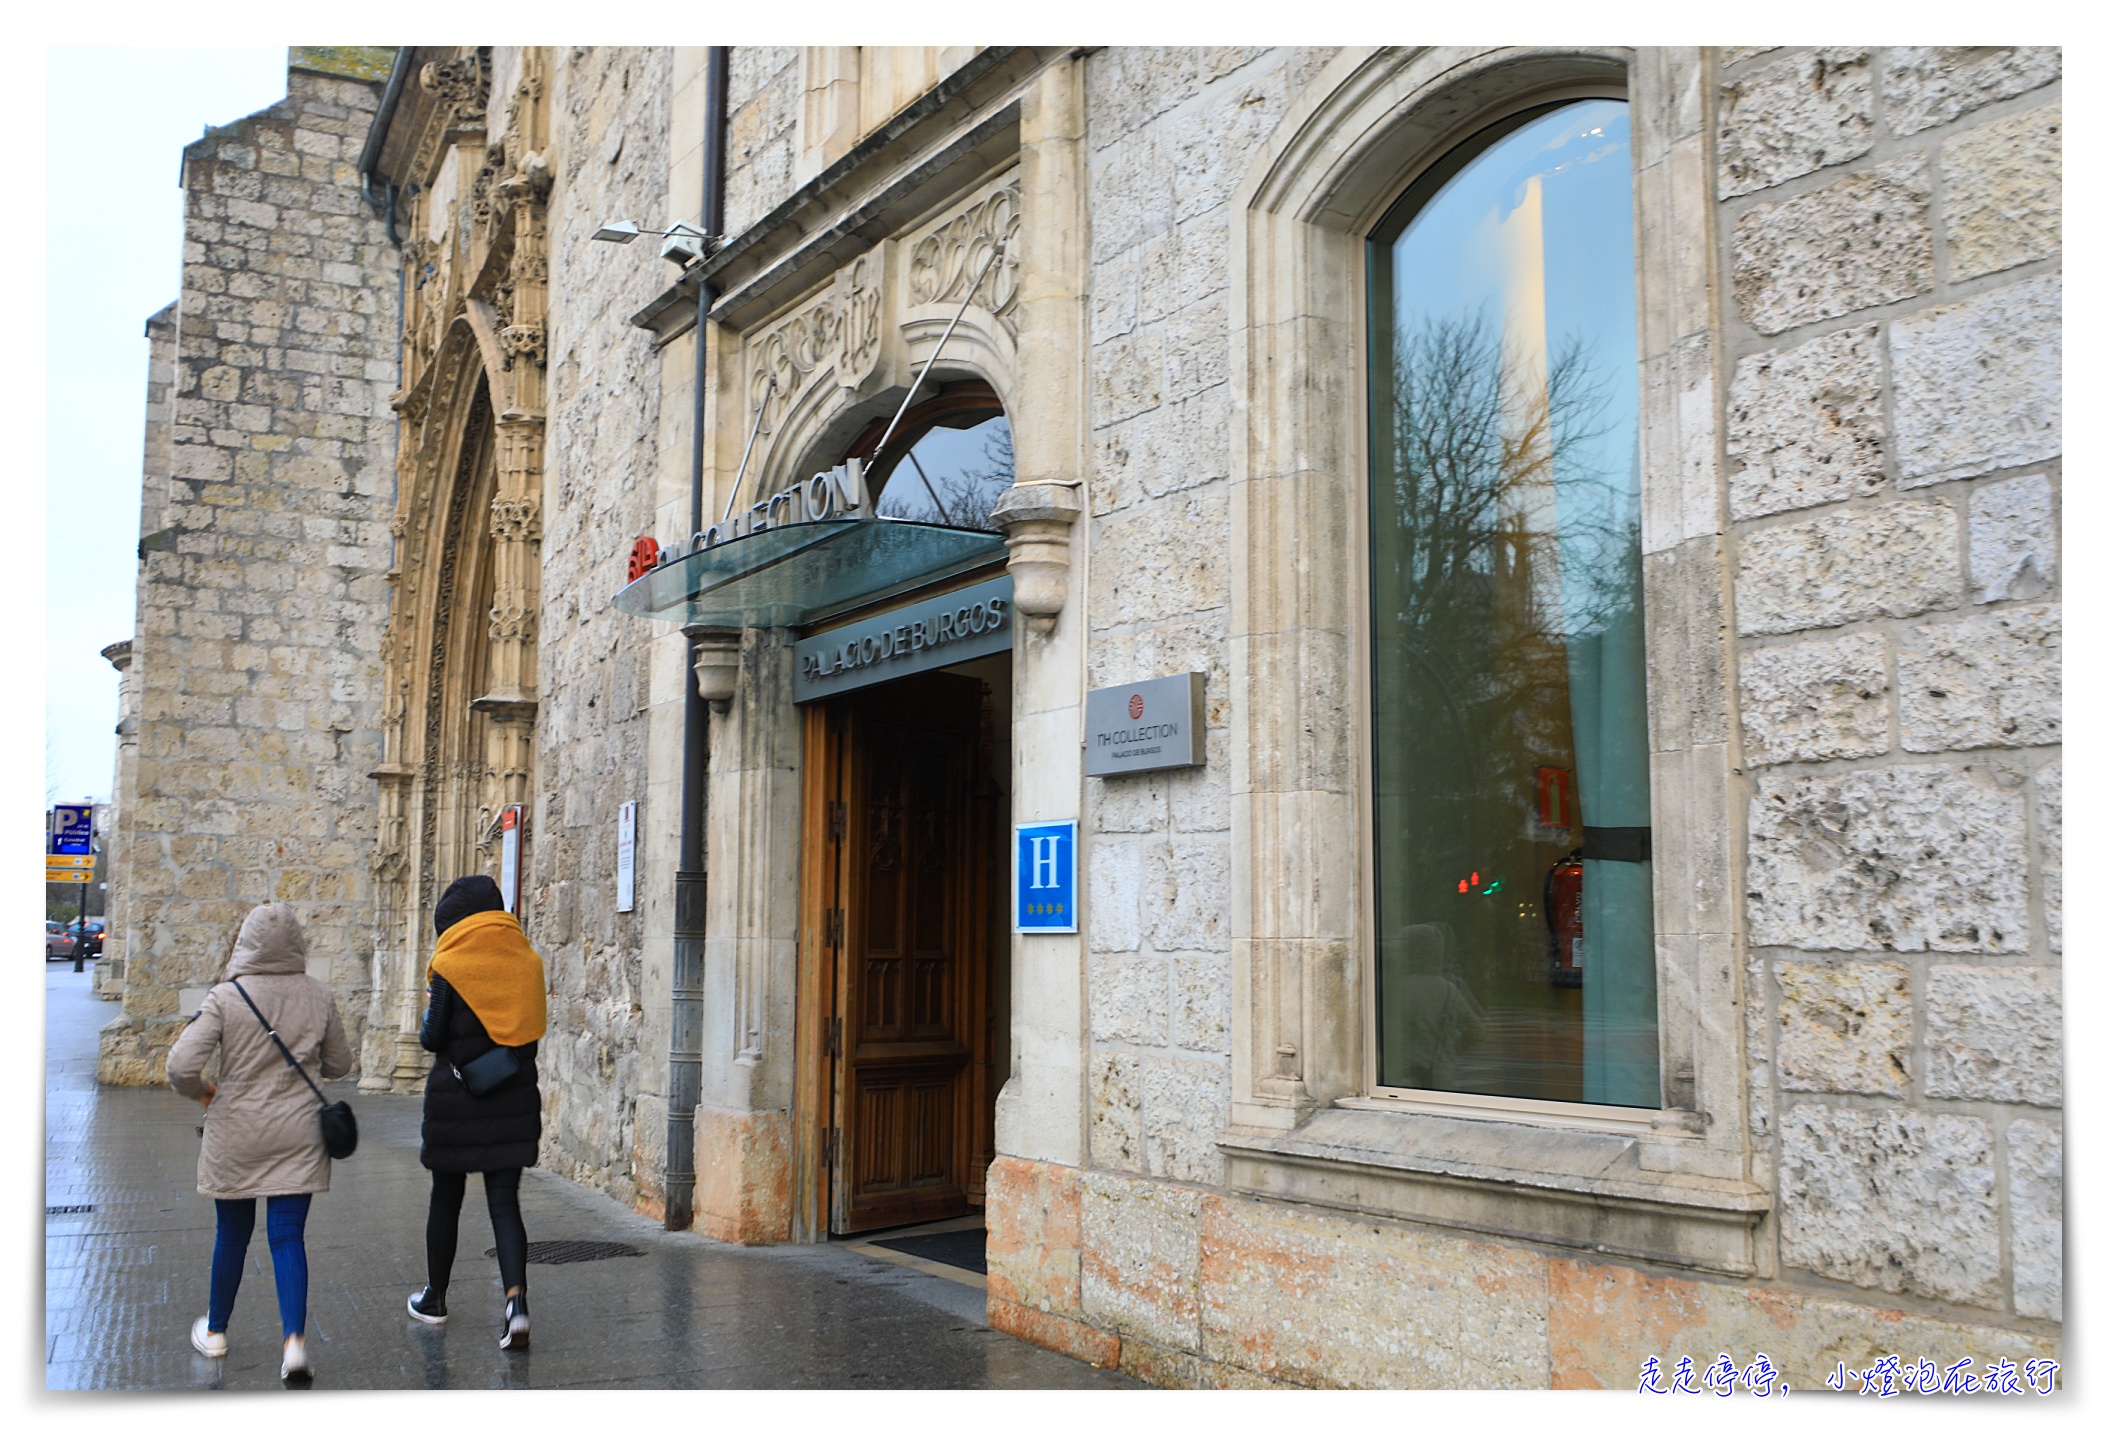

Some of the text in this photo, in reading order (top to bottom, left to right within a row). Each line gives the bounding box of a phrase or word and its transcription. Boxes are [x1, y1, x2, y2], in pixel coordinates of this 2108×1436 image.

[803, 597, 1004, 679] PALACIO DE BURGOS
[1112, 723, 1178, 745] COLLECTION
[1112, 750, 1132, 759] PALACIO
[1140, 746, 1162, 756] BURGOS
[54, 808, 78, 835] P
[1029, 835, 1061, 889] H
